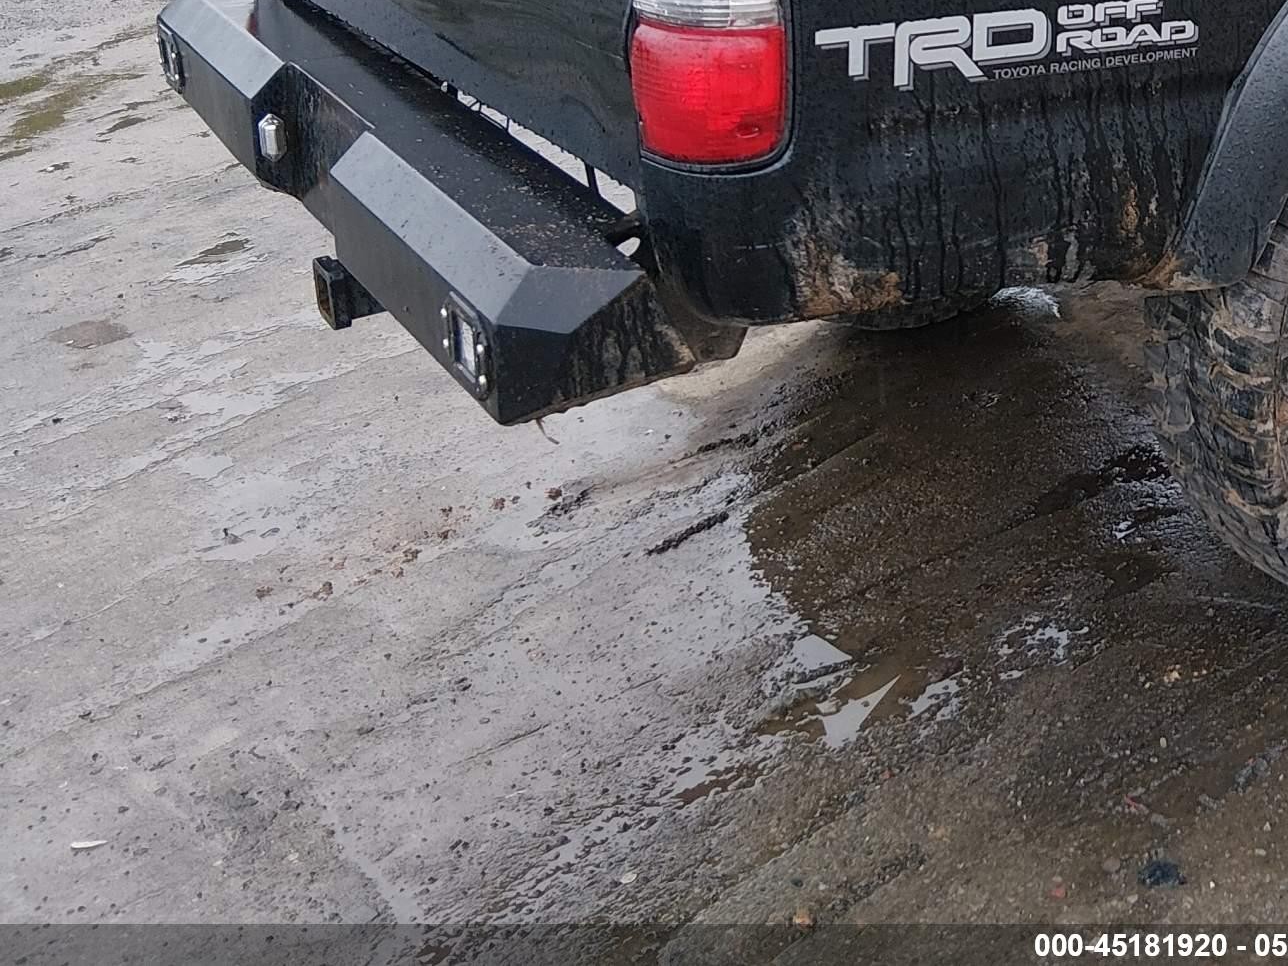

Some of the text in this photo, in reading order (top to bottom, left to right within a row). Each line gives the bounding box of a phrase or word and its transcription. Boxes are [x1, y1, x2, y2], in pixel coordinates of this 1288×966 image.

[815, 8, 1051, 91] TRD
[1056, 20, 1199, 56] ROAD
[992, 47, 1199, 80] TOYOTA RACING DEVELOPMENT
